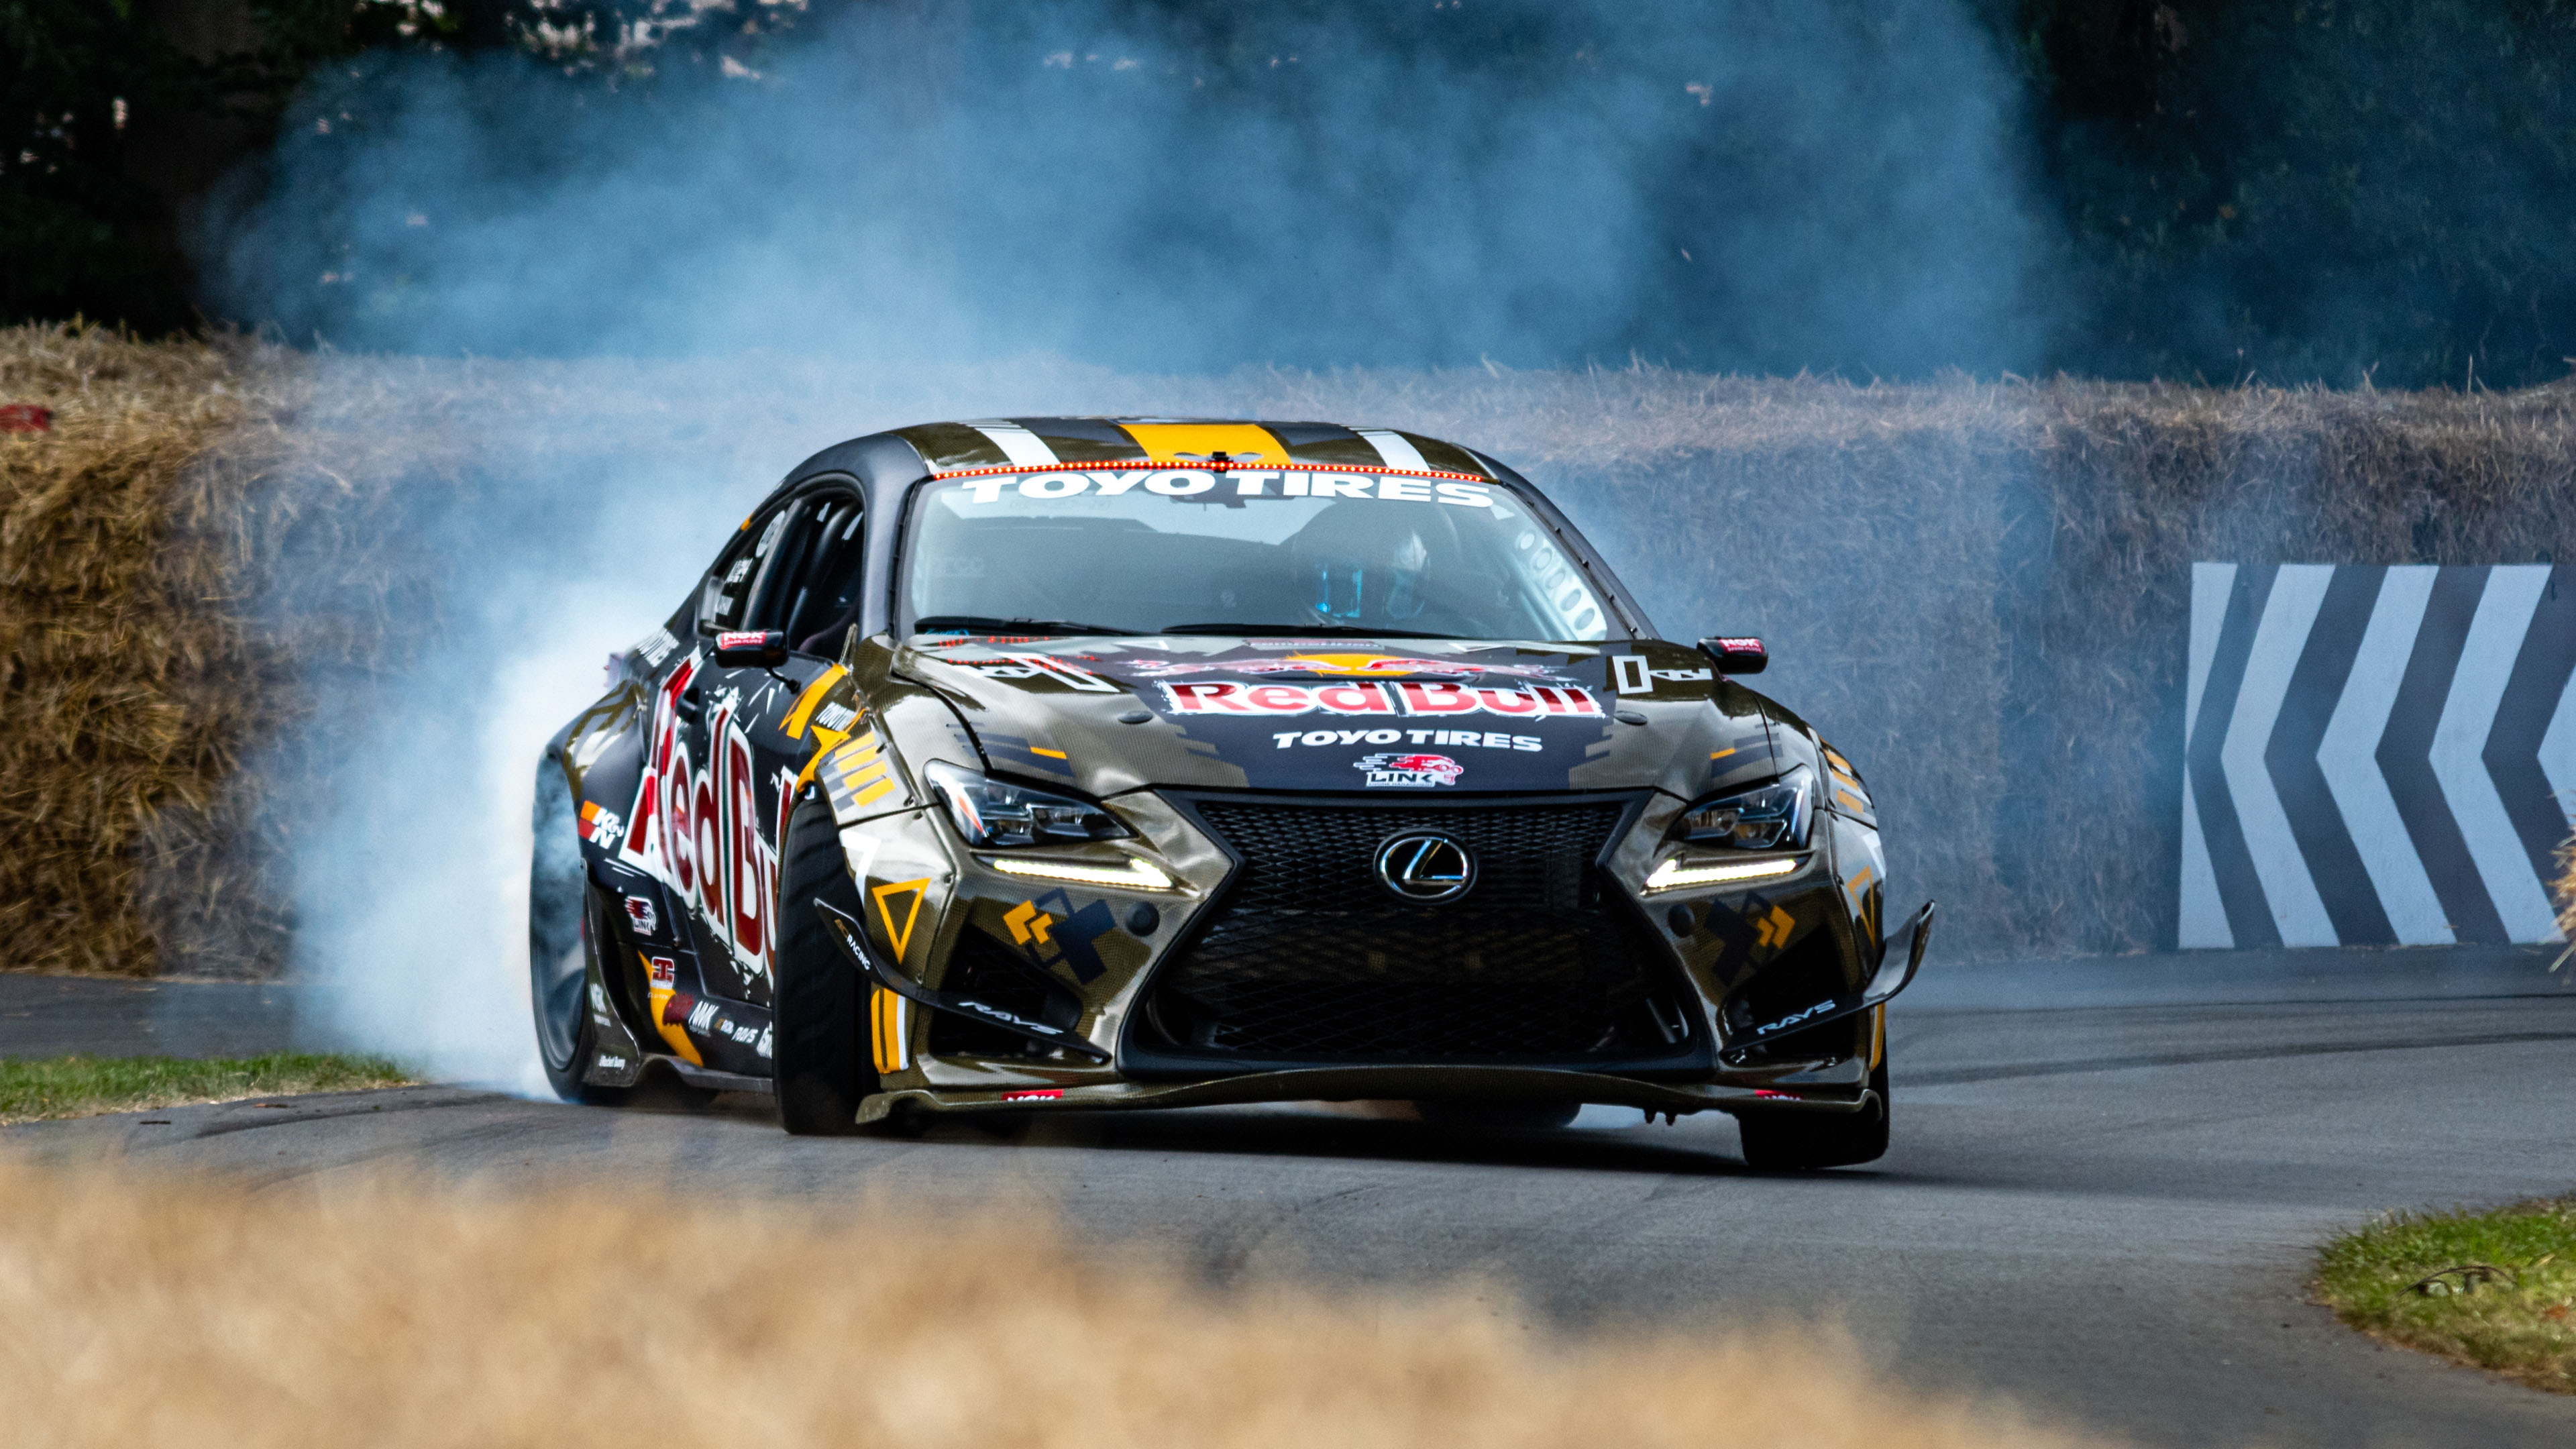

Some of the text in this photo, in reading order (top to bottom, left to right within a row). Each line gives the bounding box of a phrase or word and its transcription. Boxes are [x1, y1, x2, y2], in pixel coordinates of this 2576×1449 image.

[962, 471, 1494, 508] TOYO TIRES
[1163, 680, 1605, 718] Red Bull
[1273, 730, 1542, 752] TOYO TIRES
[619, 644, 733, 950] Red
[1371, 773, 1434, 784] LINK
[589, 807, 625, 849] K&N
[847, 933, 871, 971] RACING
[959, 1002, 1064, 1034] RAYS
[1757, 999, 1836, 1035] RAYS
